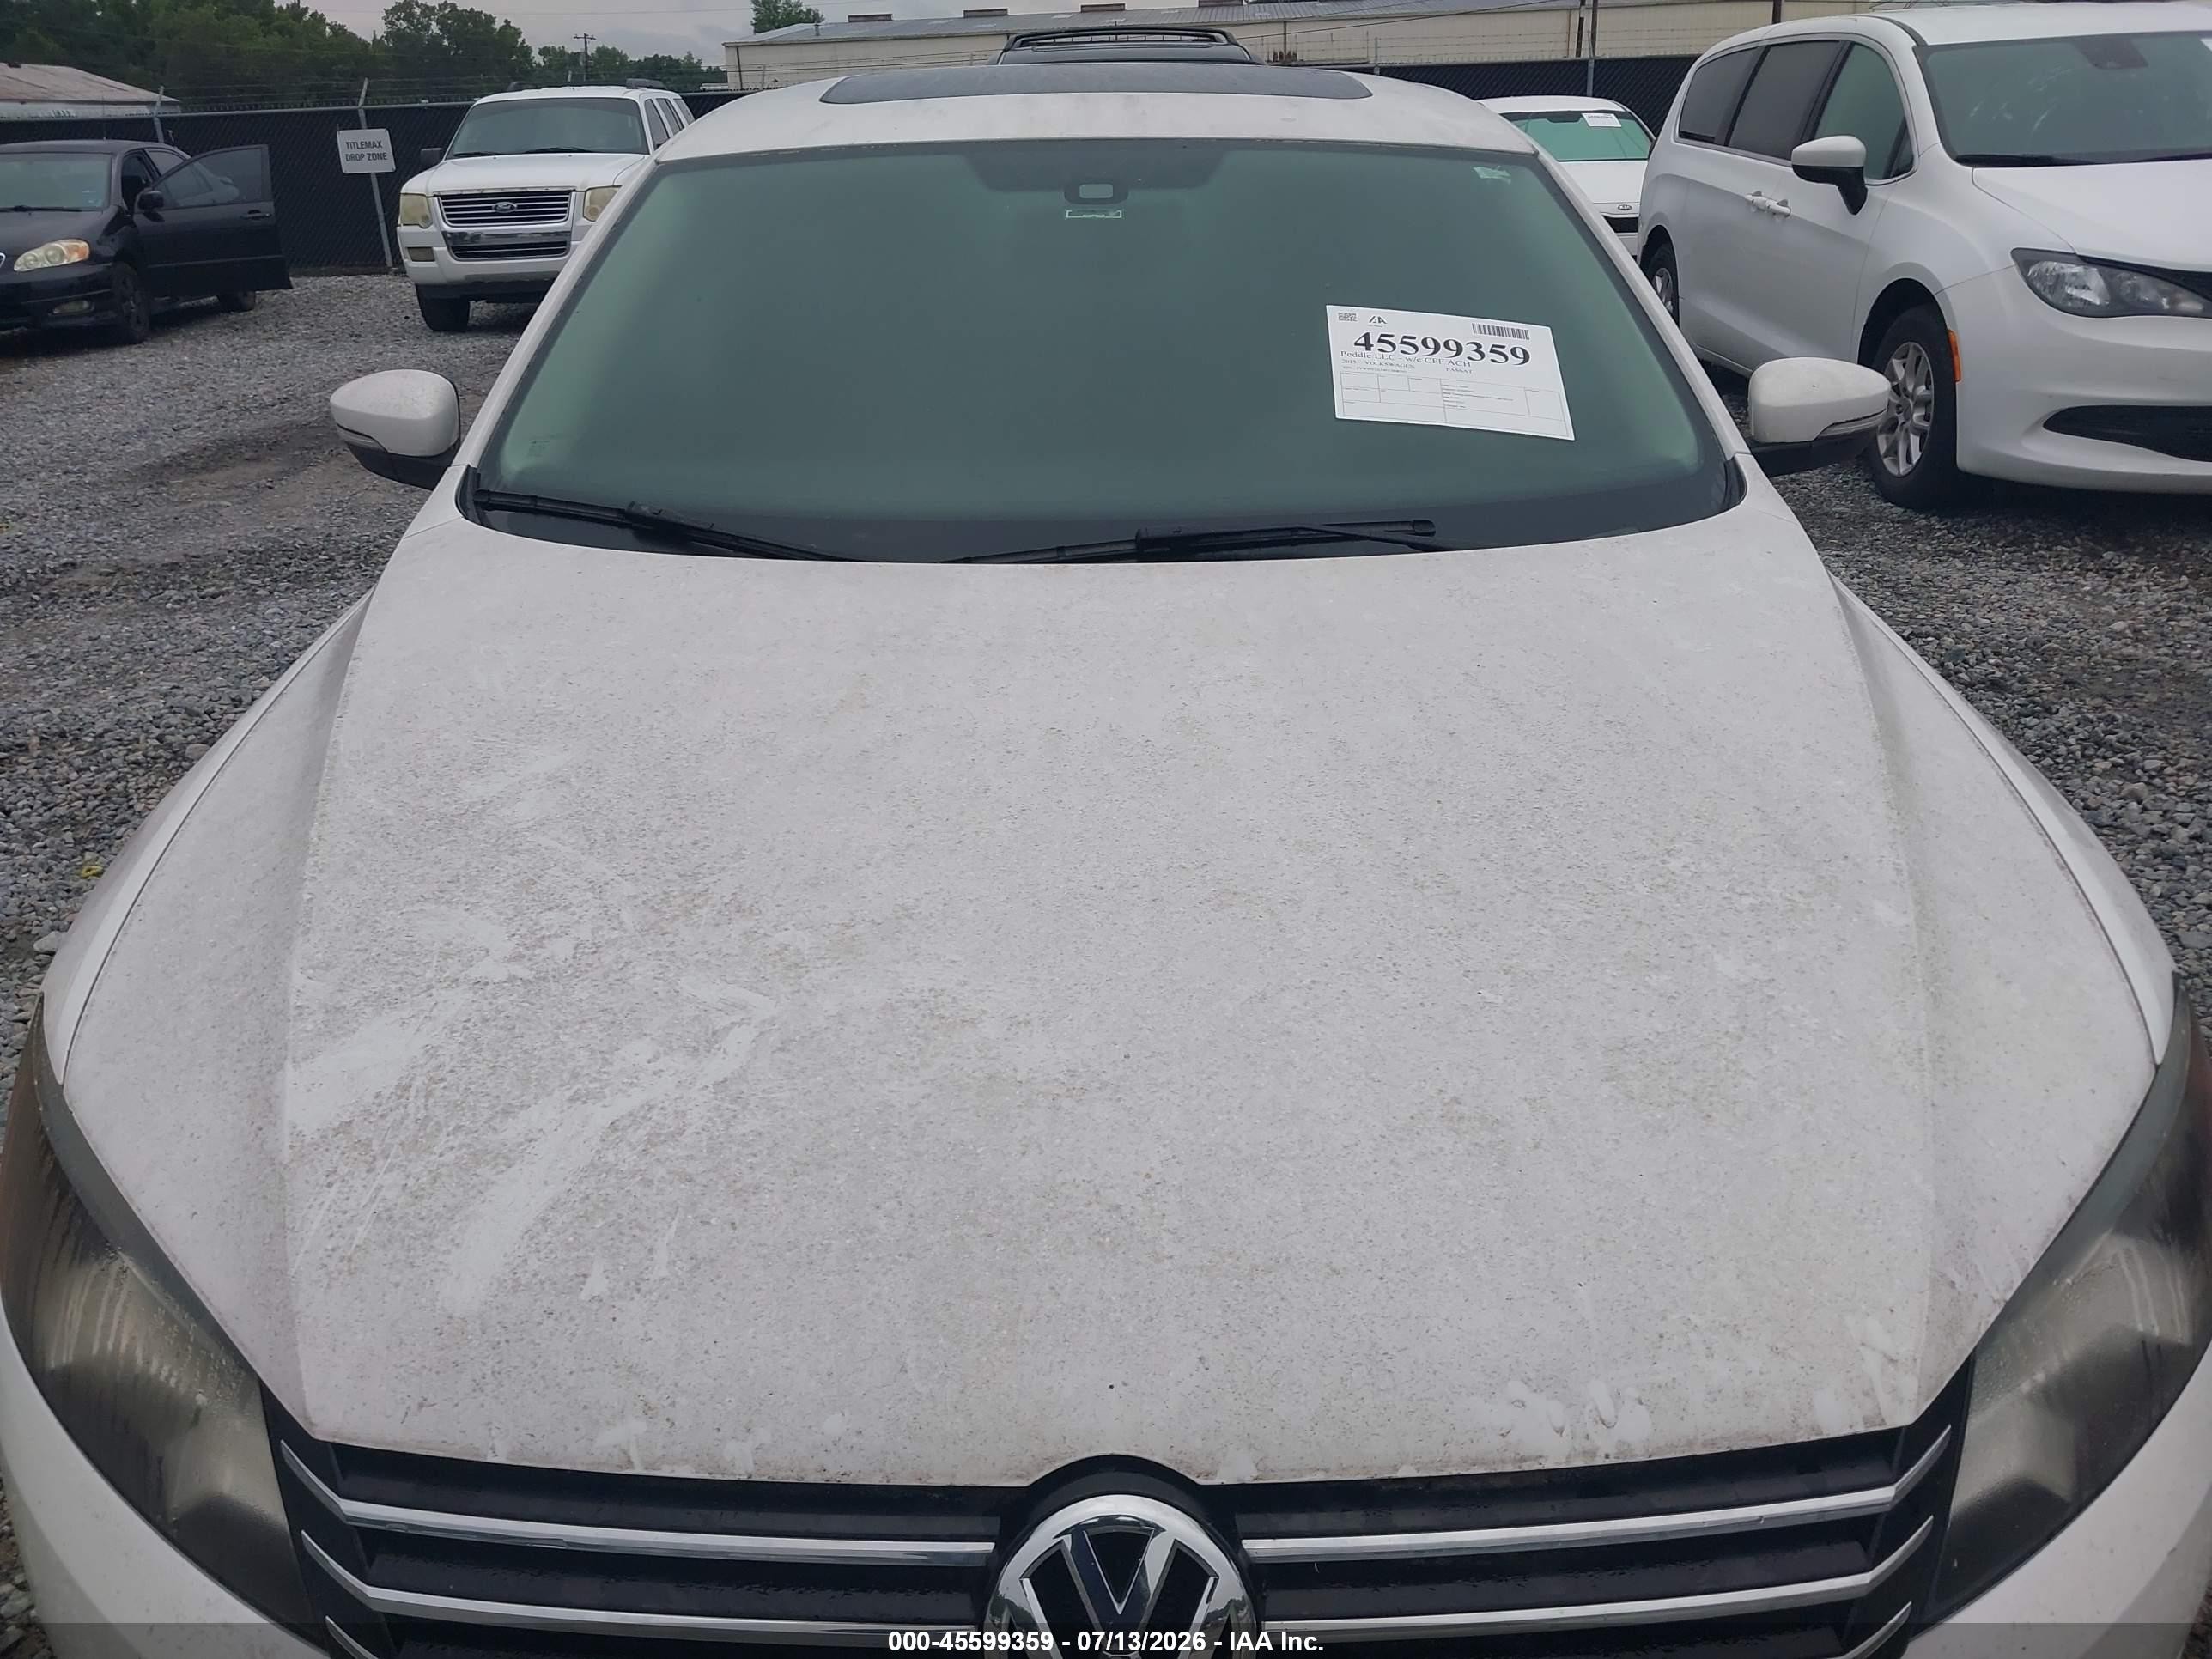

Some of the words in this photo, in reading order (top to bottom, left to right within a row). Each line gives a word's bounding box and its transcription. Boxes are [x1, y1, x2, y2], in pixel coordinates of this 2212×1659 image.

[345, 141, 383, 149] TITLEMAX
[345, 153, 365, 161] DROP
[367, 152, 388, 161] ZONE
[1353, 331, 1531, 366] 45599359
[1340, 350, 1372, 359] Peddle
[1364, 360, 1415, 368] VOLKSWAGEN
